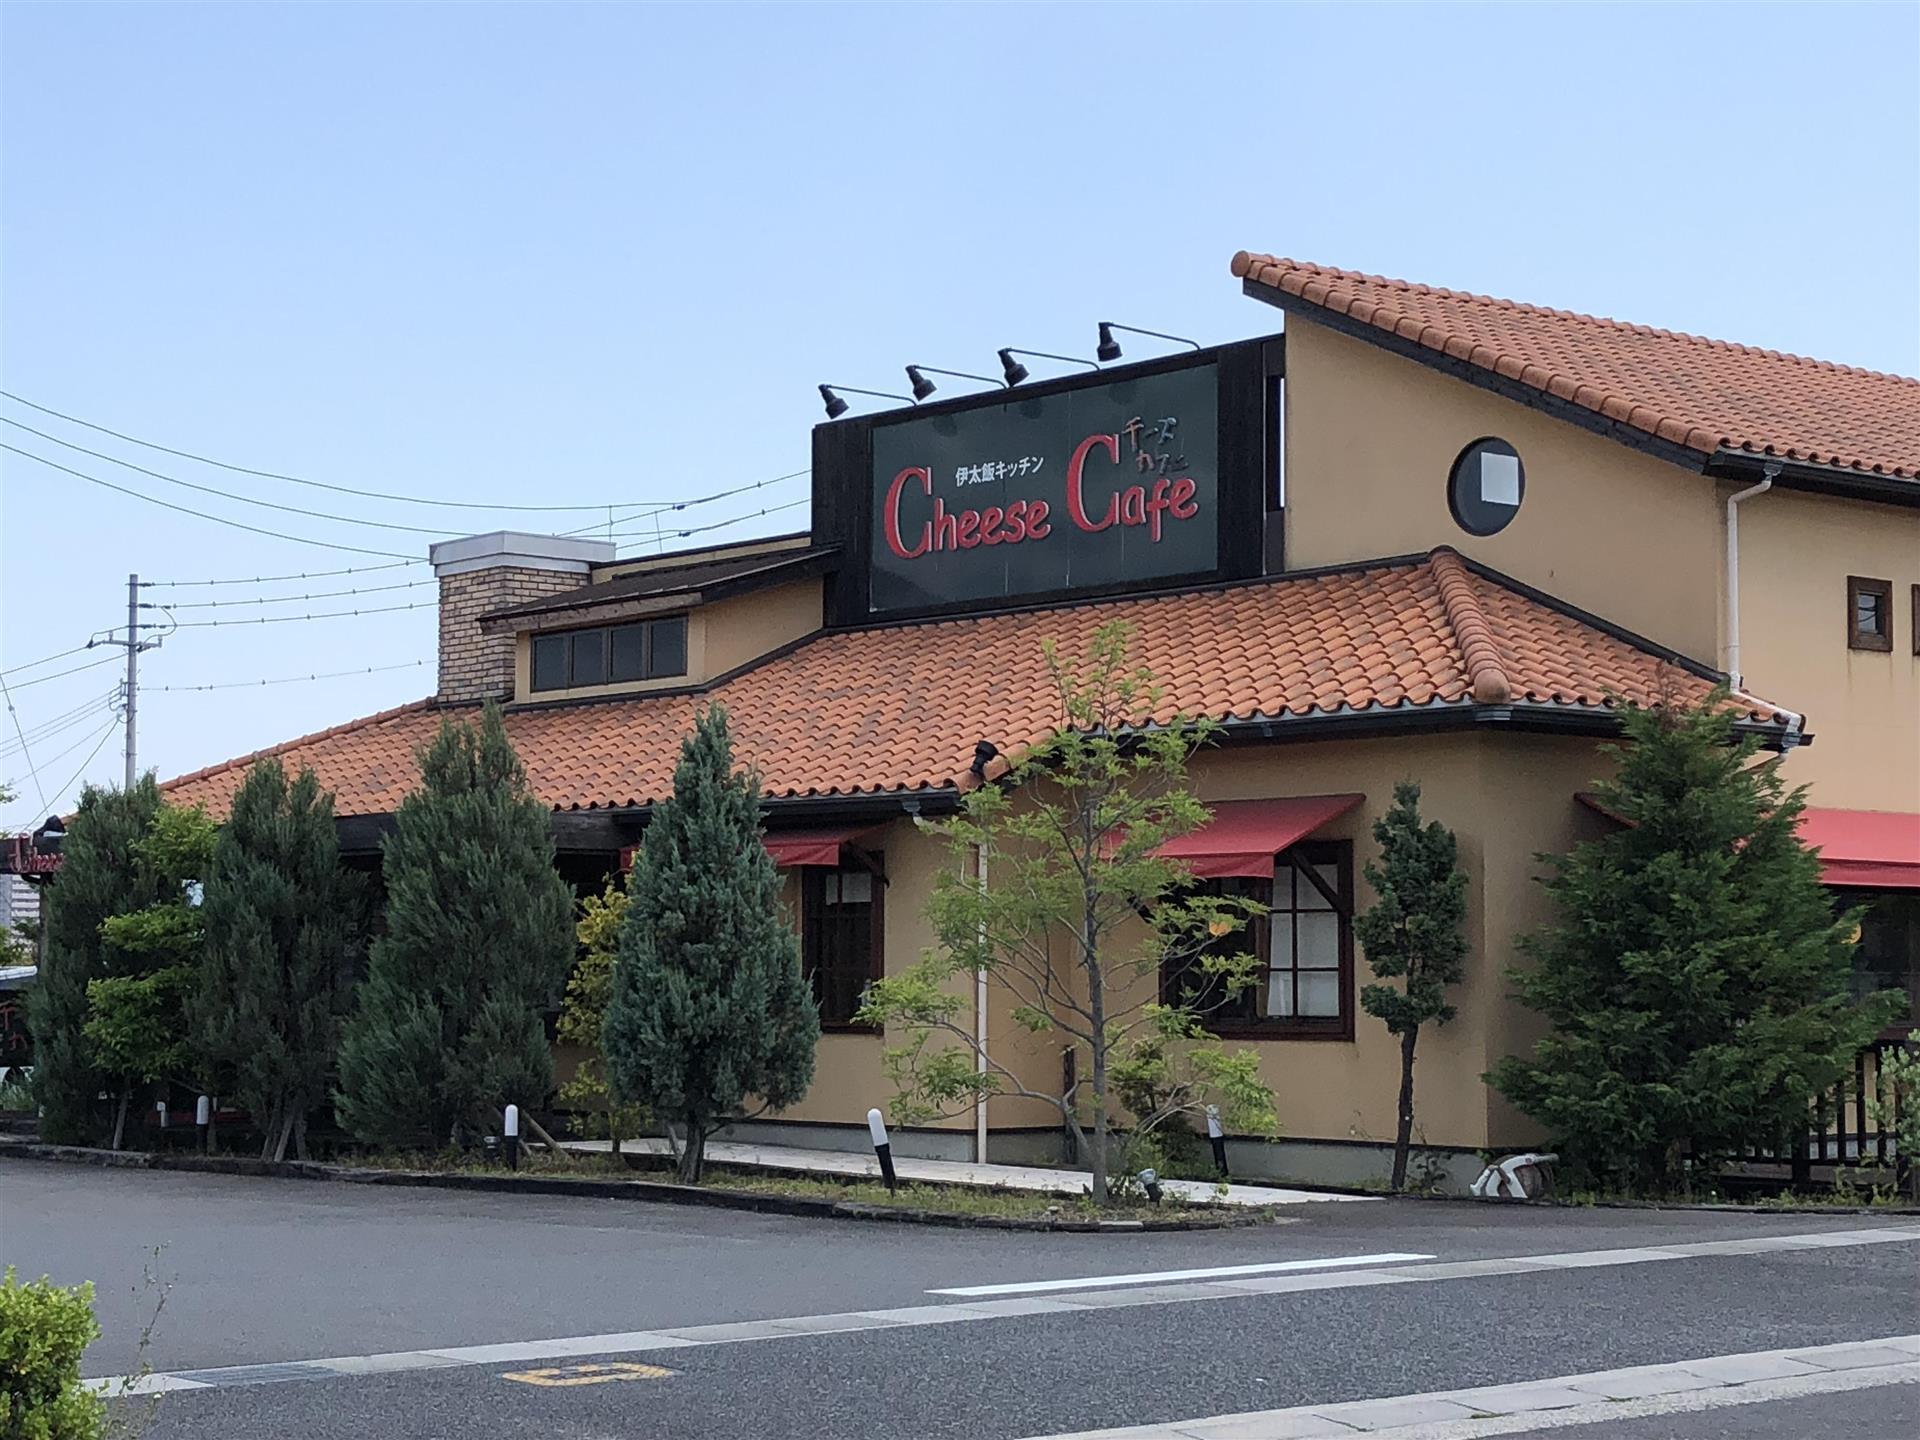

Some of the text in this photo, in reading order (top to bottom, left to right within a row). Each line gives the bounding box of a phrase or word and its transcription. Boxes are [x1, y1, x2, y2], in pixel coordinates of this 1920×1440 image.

[883, 433, 1199, 559] Cheese Cafe
[955, 456, 1044, 487] 伊太飯キッチン
